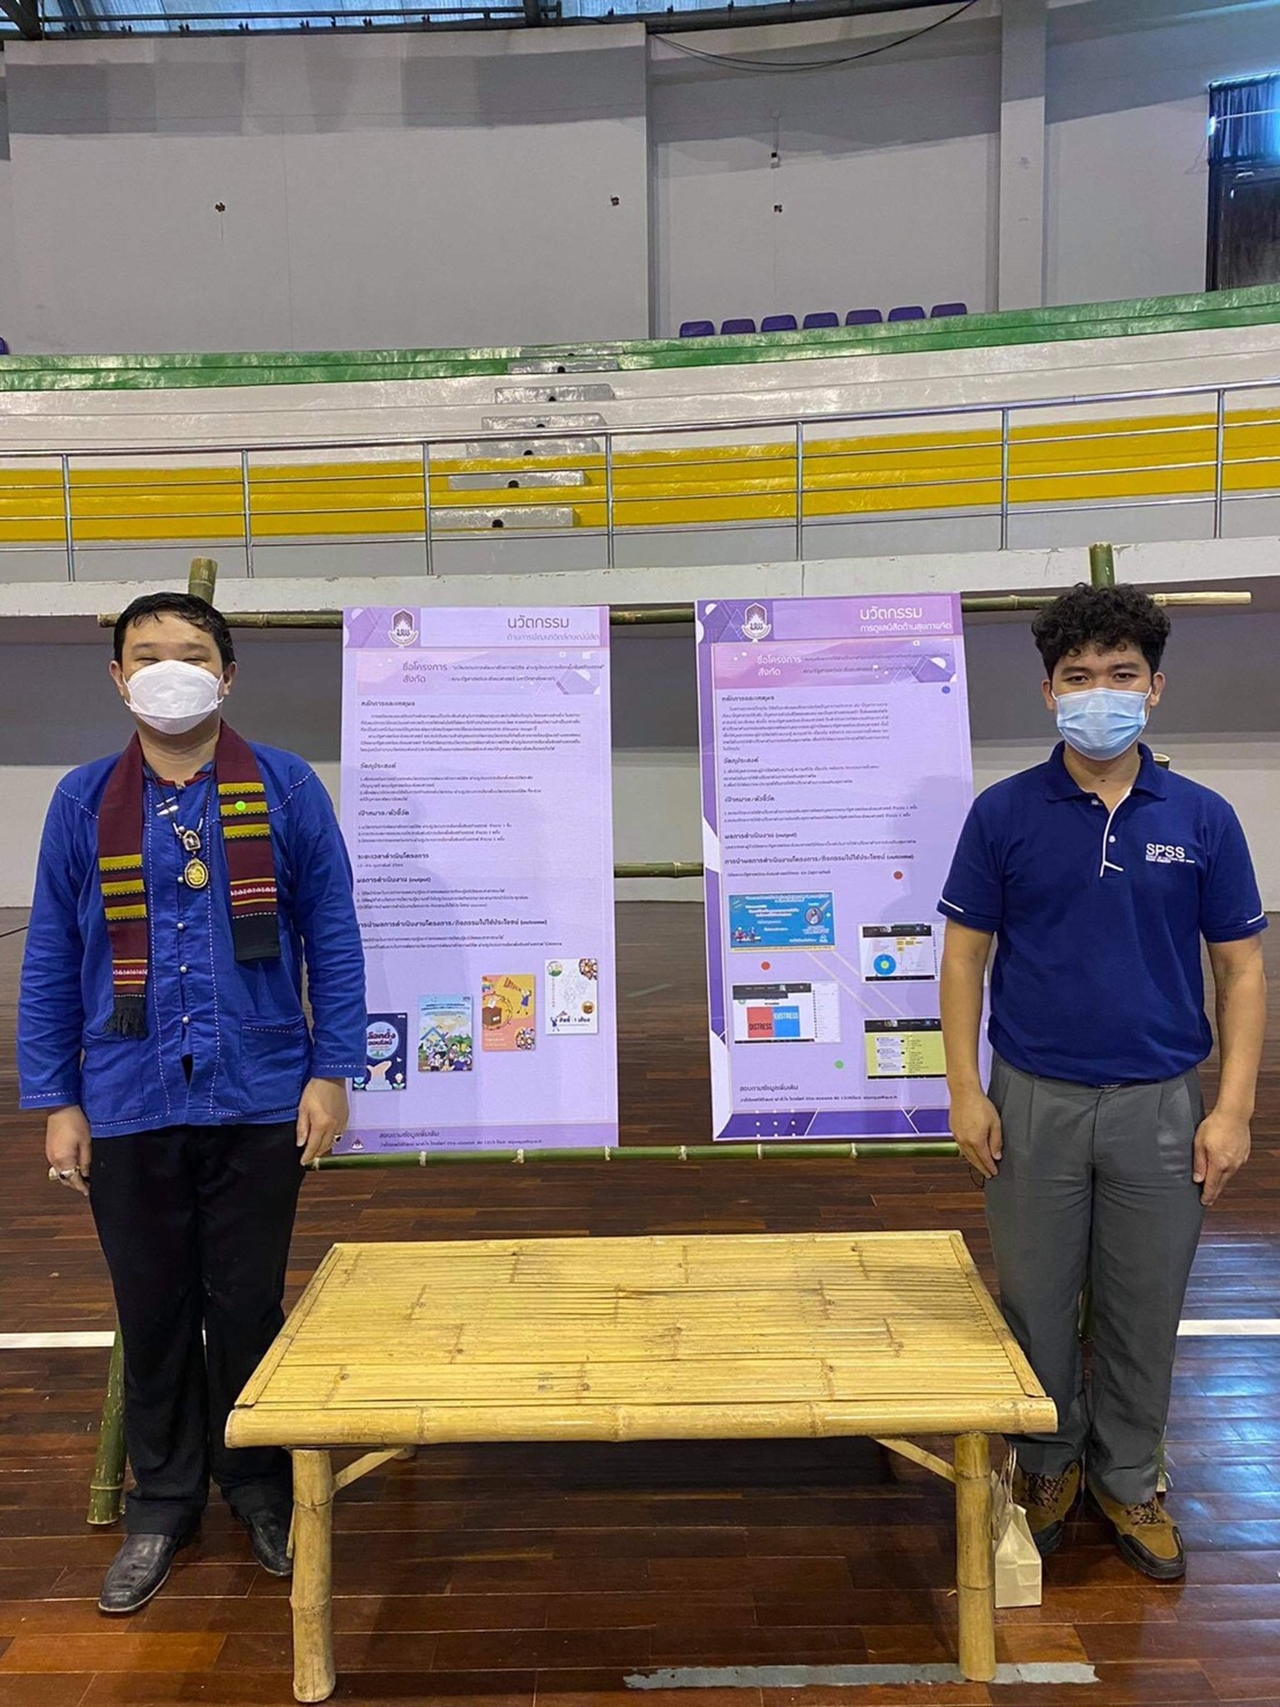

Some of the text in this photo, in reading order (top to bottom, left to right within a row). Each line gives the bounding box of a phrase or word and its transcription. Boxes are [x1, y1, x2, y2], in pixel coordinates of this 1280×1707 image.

[859, 606, 923, 620] นวัตกรรม
[507, 614, 570, 629] นวัตกรรม
[756, 653, 802, 665] ชื่อโครงการ
[402, 660, 448, 672] ชื่อโครงการ
[757, 667, 781, 677] สังกัด
[402, 675, 426, 684] สังกัด
[1145, 842, 1186, 859] SPSS
[749, 1023, 773, 1031] DISTRESS
